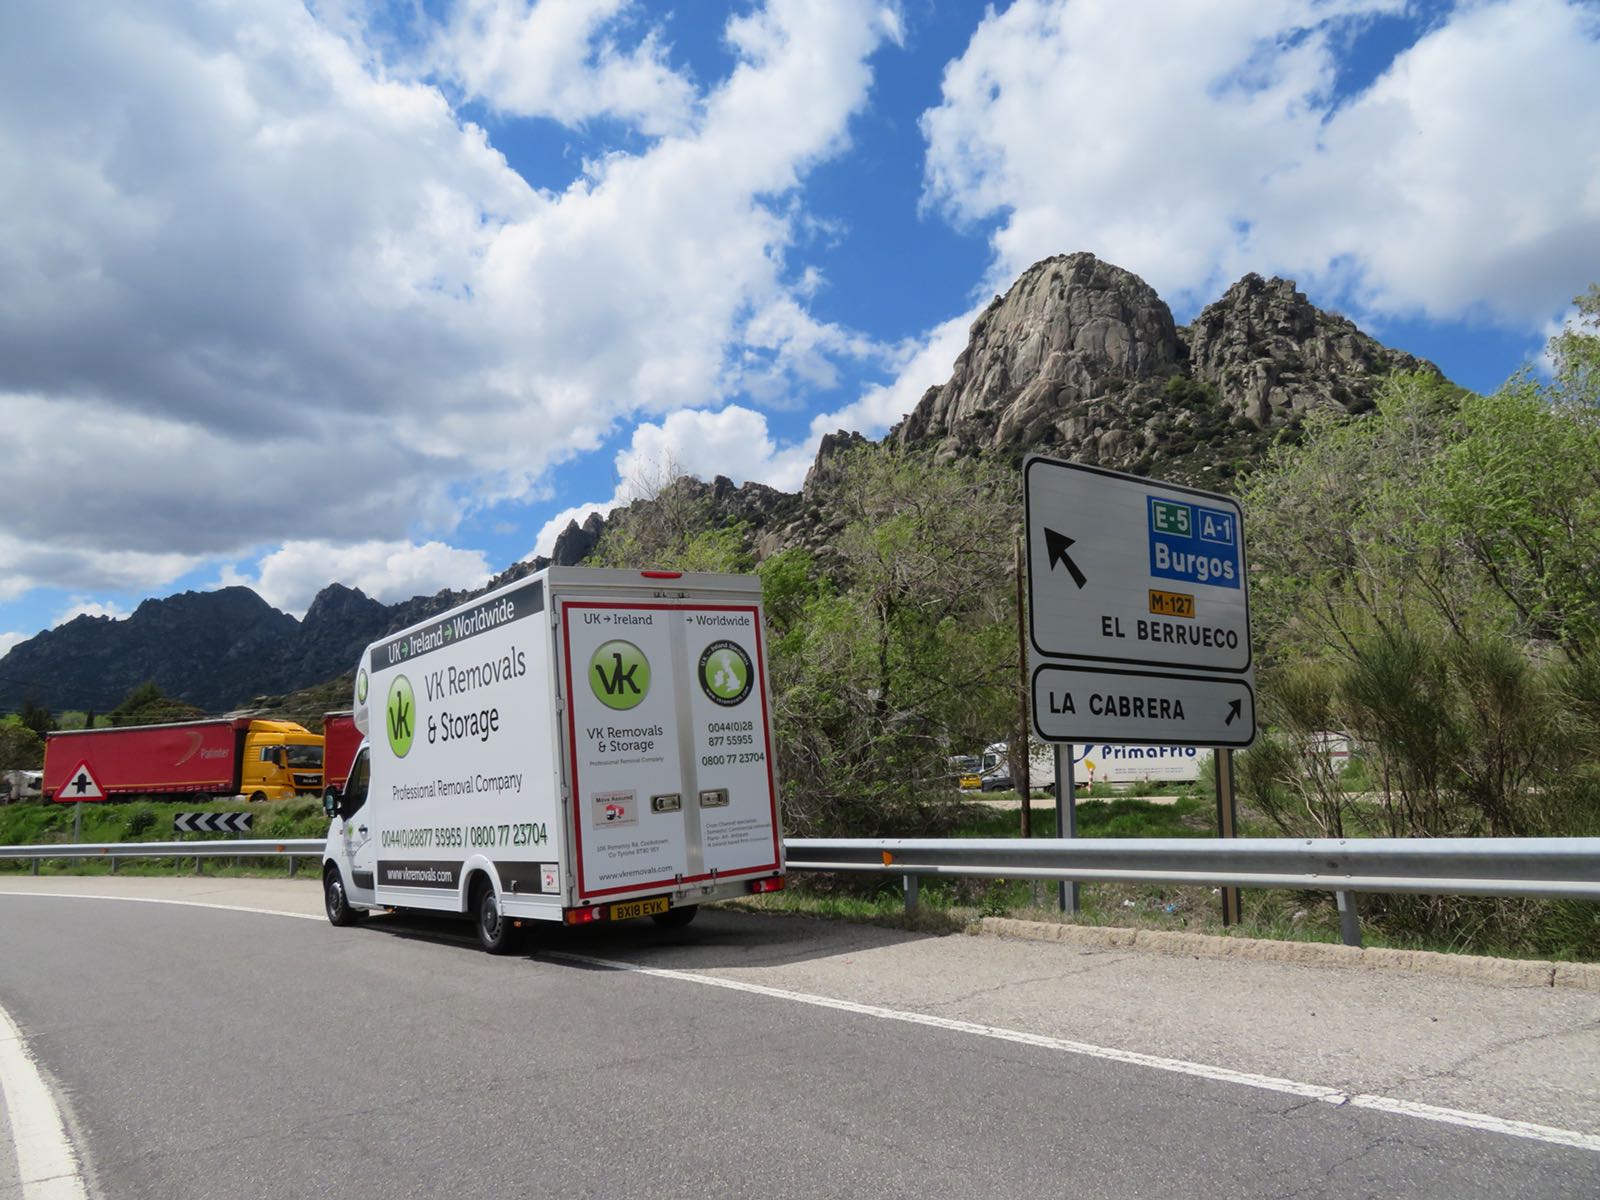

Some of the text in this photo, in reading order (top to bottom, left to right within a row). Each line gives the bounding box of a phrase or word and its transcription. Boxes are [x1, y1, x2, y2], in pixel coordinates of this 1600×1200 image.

[1155, 505, 1188, 532] E-5
[1203, 516, 1231, 540] A-1
[1154, 542, 1235, 582] Burgos
[1151, 593, 1192, 615] M-127
[584, 613, 653, 625] UK Ireland
[696, 615, 750, 626] Worldwide
[388, 598, 515, 664] UK Ireland Worldwide
[1101, 615, 1238, 650] EL BERRUECO
[425, 646, 527, 702] VK Removals
[1049, 691, 1185, 721] LA CABRERA
[427, 707, 499, 744] & Storage
[587, 725, 664, 740] VK Removals
[708, 721, 753, 733] 0044(0)28
[610, 739, 655, 753] Storage
[708, 734, 753, 747] 877 55955
[701, 752, 765, 766] 0800 77 23704
[392, 773, 523, 801] Professional Removal Company
[434, 826, 462, 849] 55955
[471, 824, 496, 848] 0800
[497, 824, 511, 846] 77
[513, 822, 548, 848] 23704
[387, 867, 453, 883] www.vkremovals.com
[599, 865, 673, 881] www.vkremovals.com
[617, 901, 663, 920] BX18 EVK
